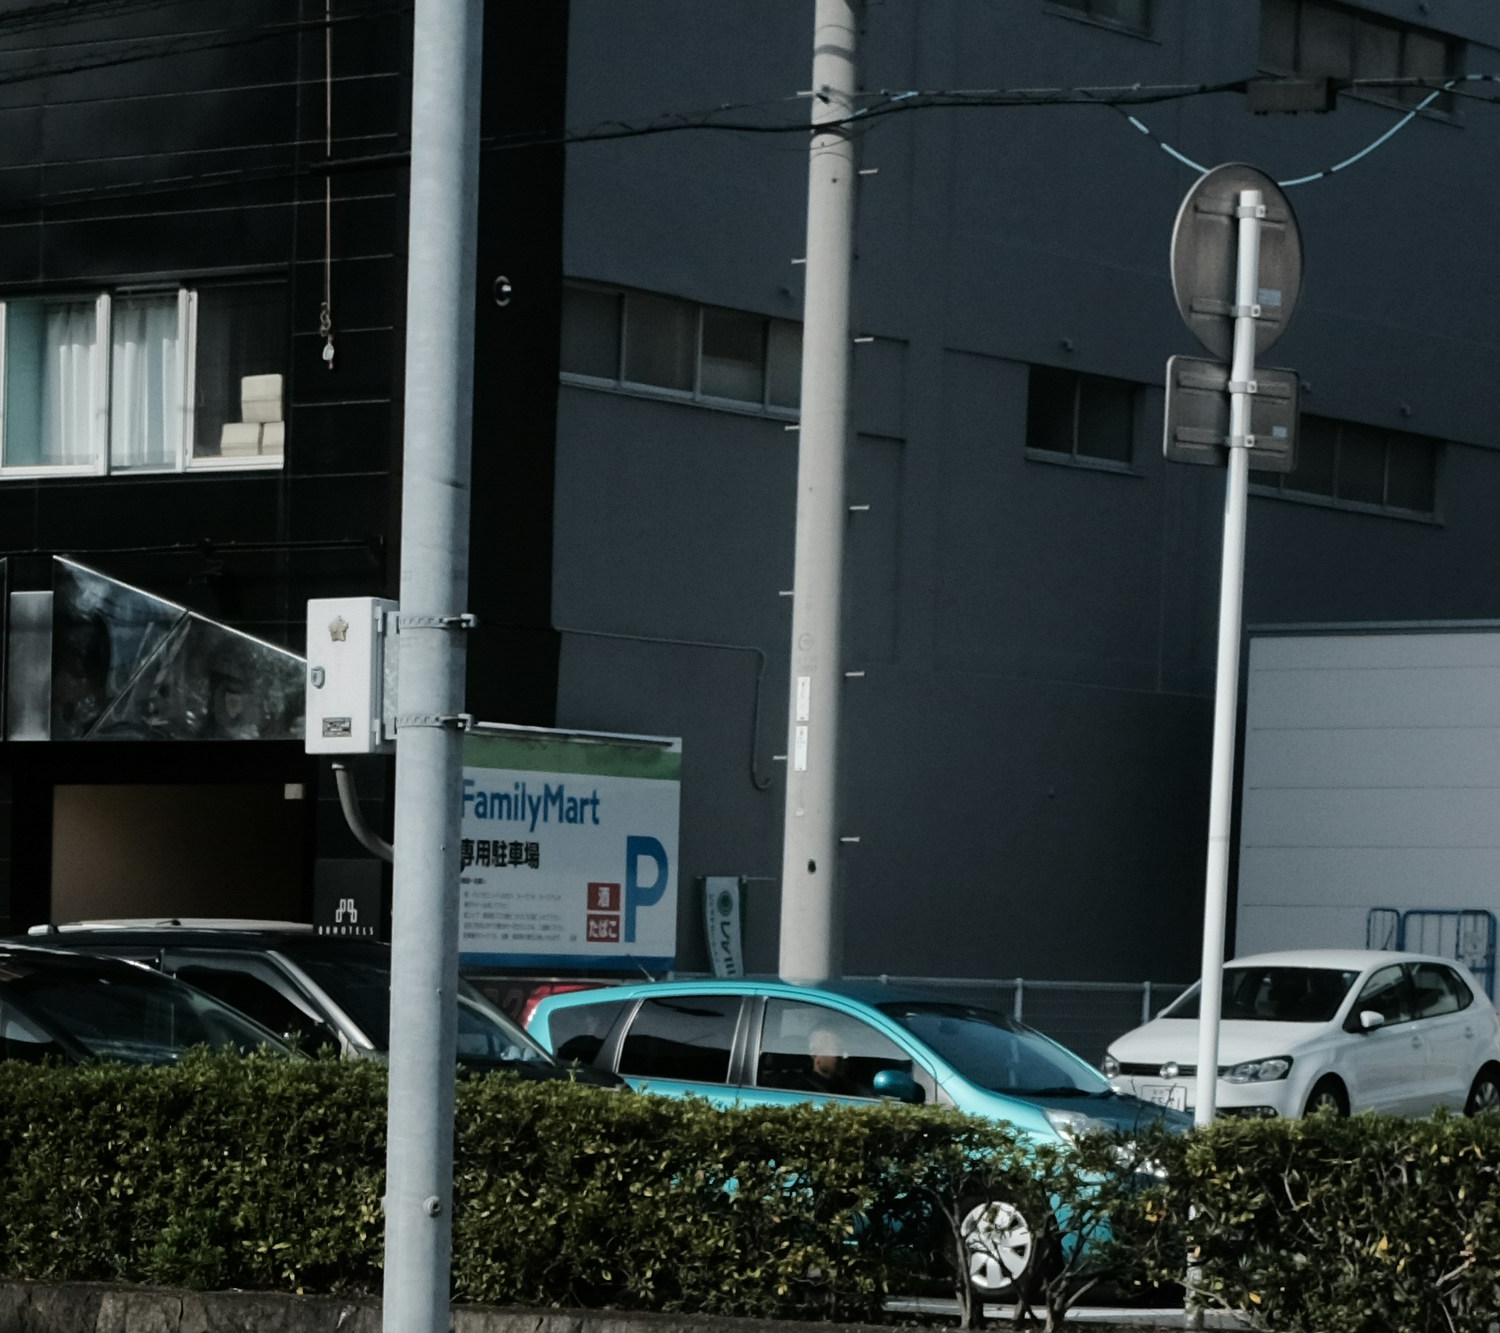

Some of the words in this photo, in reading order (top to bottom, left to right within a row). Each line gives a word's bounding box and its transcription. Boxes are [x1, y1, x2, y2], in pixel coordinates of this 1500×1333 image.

[462, 779, 600, 834] FamilyMart
[461, 839, 540, 871] 専用駐車場
[597, 887, 611, 908] 酒
[625, 835, 668, 943] P
[588, 919, 619, 939] たばこ
